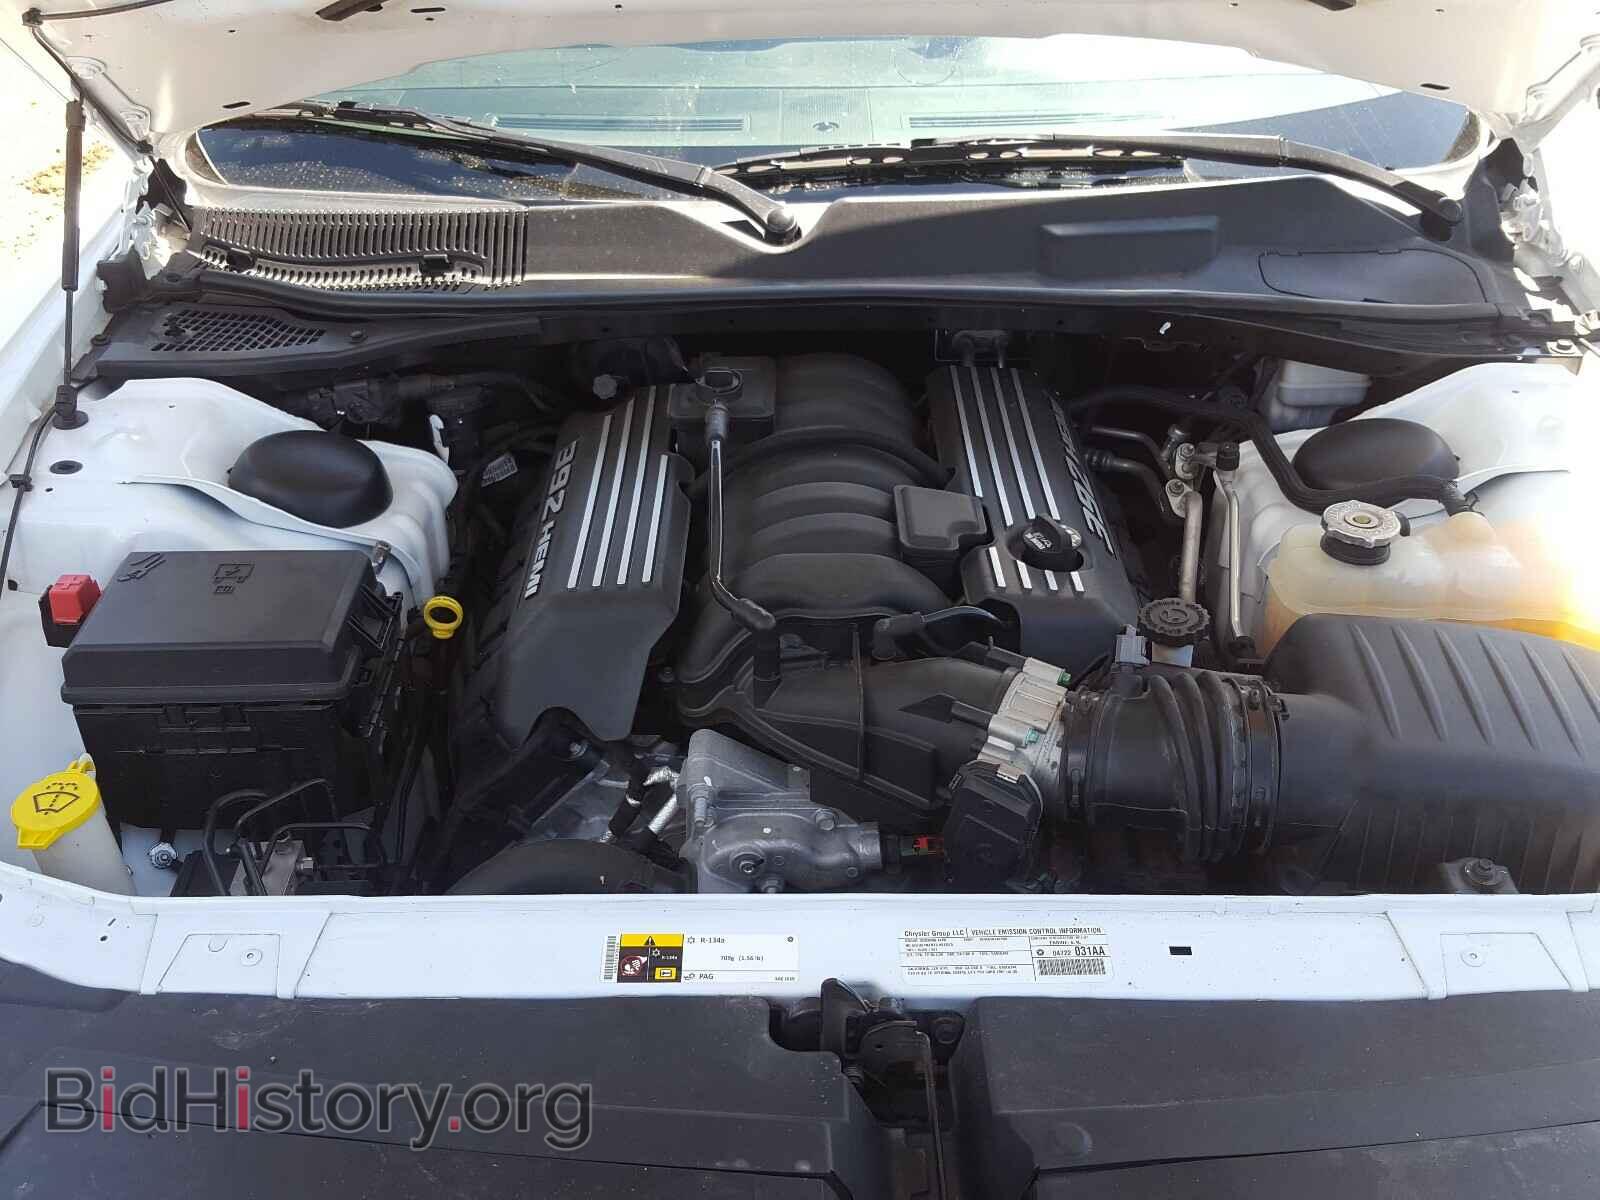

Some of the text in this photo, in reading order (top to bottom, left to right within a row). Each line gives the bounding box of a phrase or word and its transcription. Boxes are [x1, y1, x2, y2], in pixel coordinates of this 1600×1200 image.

[524, 440, 577, 600] 392 HEMI
[904, 927, 1102, 938] Chrysler Group LLC VEHICLE EMISSION CONTROL INFORMATION
[700, 936, 725, 944] R-134a
[1074, 945, 1106, 956] 031AA
[699, 972, 714, 980] PAG
